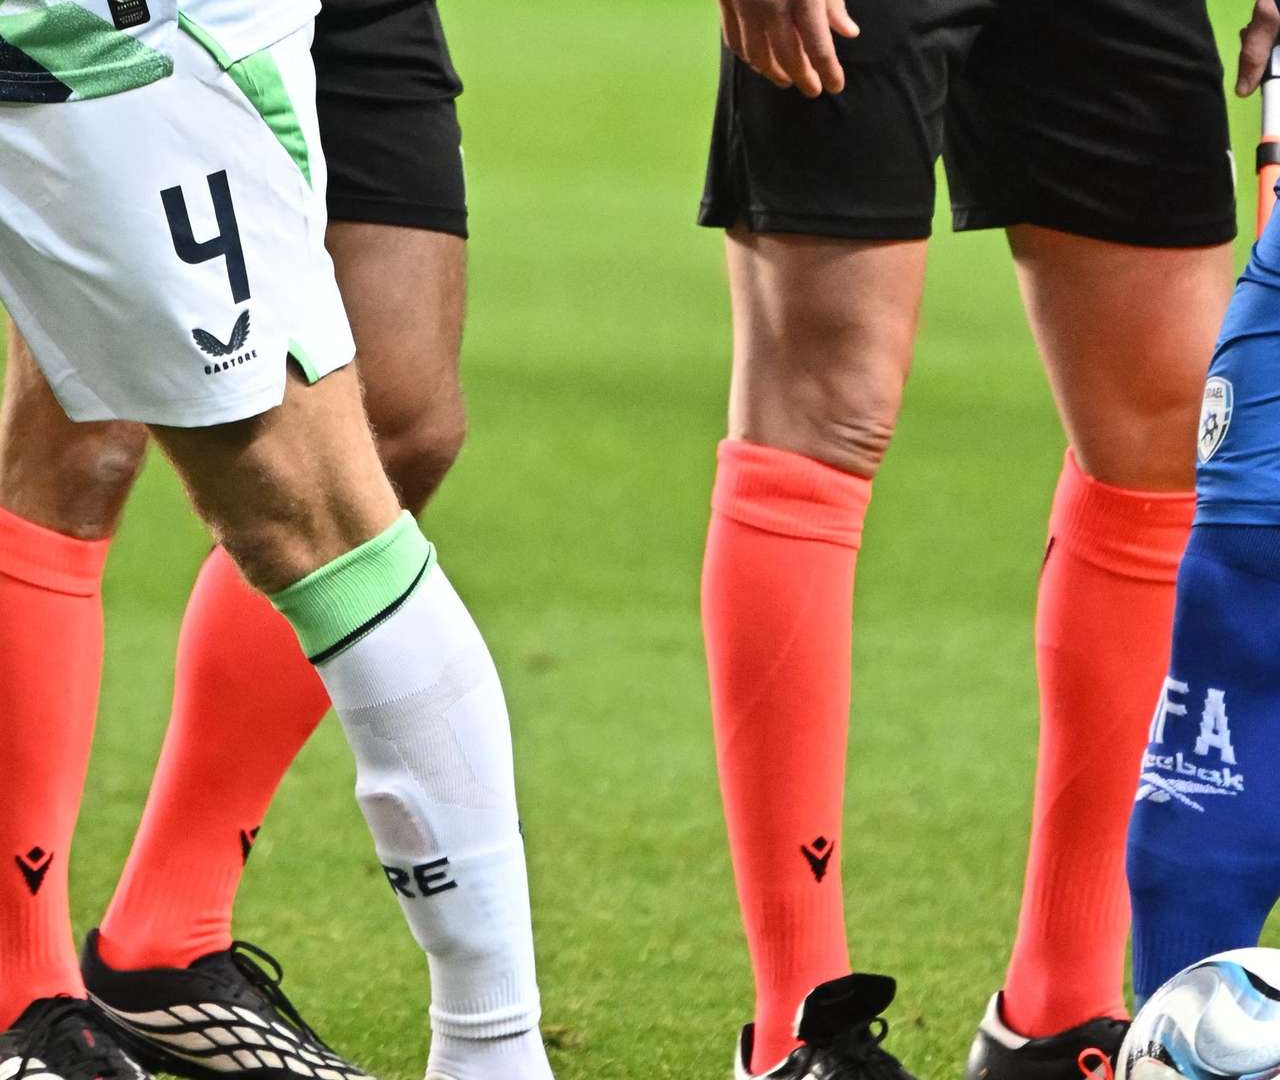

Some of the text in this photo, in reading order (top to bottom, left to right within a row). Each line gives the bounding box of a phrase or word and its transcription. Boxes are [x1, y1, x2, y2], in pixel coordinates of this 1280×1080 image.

[160, 169, 250, 304] 4
[204, 349, 258, 376] CASTORE
[1140, 752, 1244, 791] eebok
